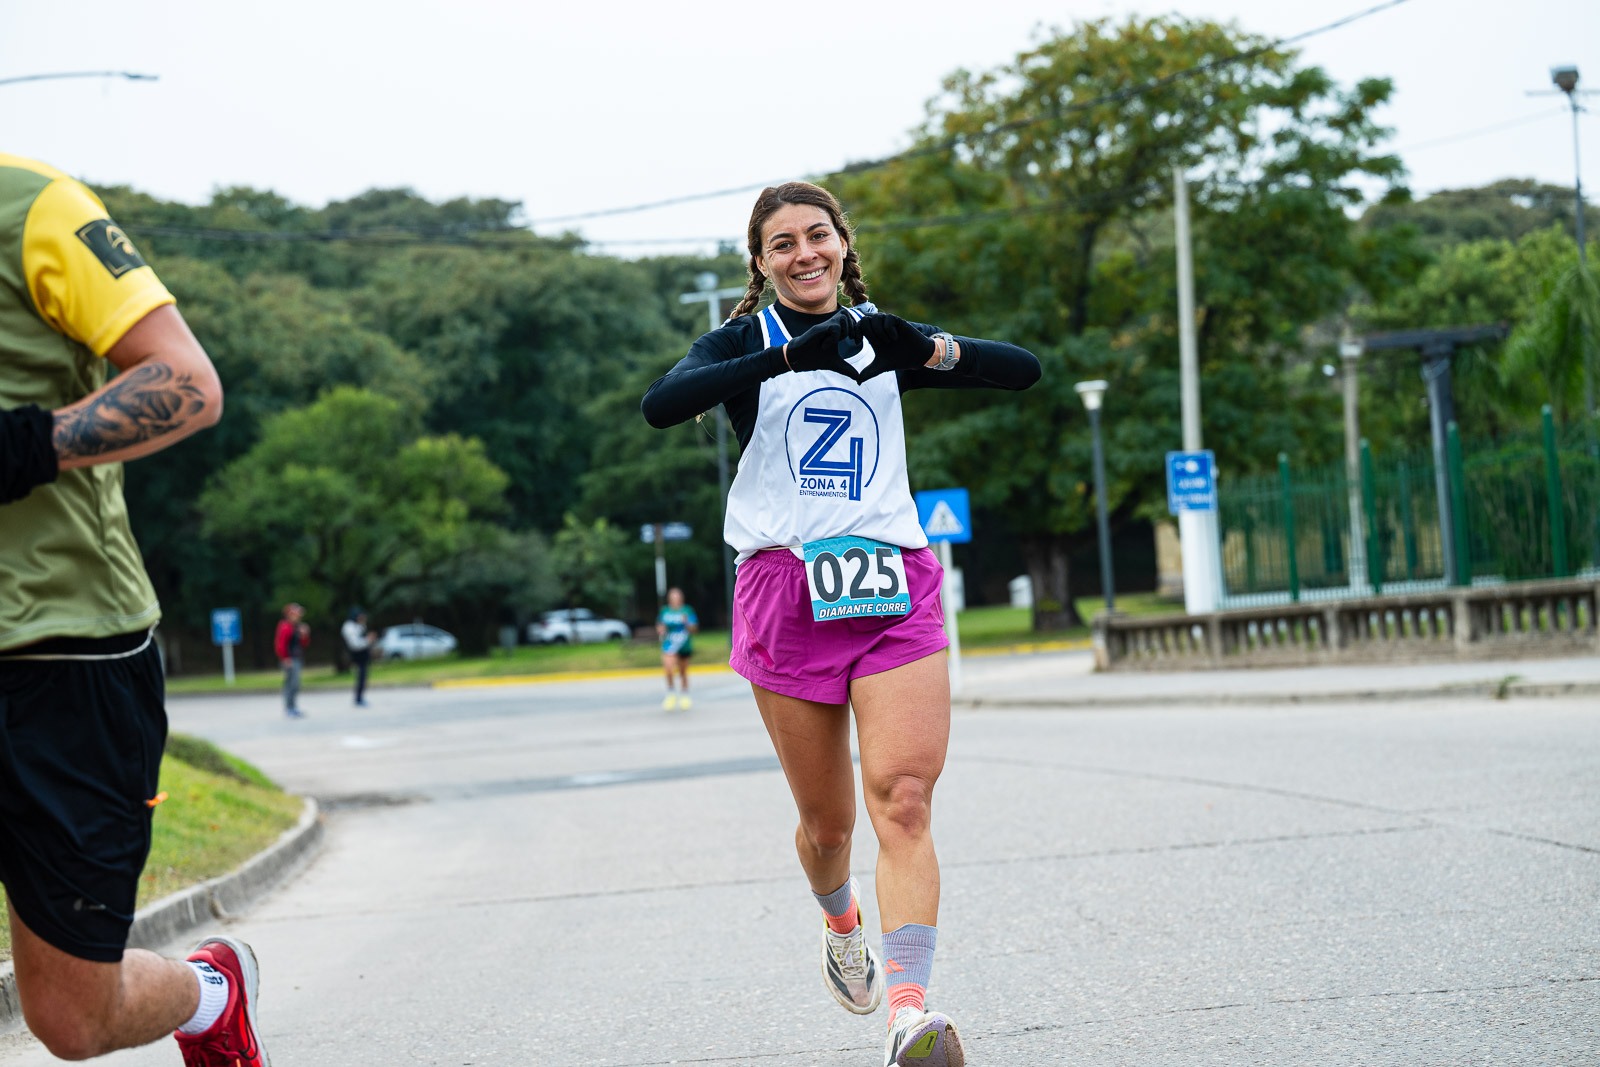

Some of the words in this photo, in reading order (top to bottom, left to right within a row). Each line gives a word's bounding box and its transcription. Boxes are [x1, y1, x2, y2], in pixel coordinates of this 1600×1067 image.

[800, 477, 835, 490] ZONA
[840, 479, 847, 490] 4
[799, 489, 847, 498] ENTRENAMIENTOS
[813, 547, 899, 603] 025
[818, 603, 874, 619] DIAMANTE
[875, 602, 907, 613] CORRE
